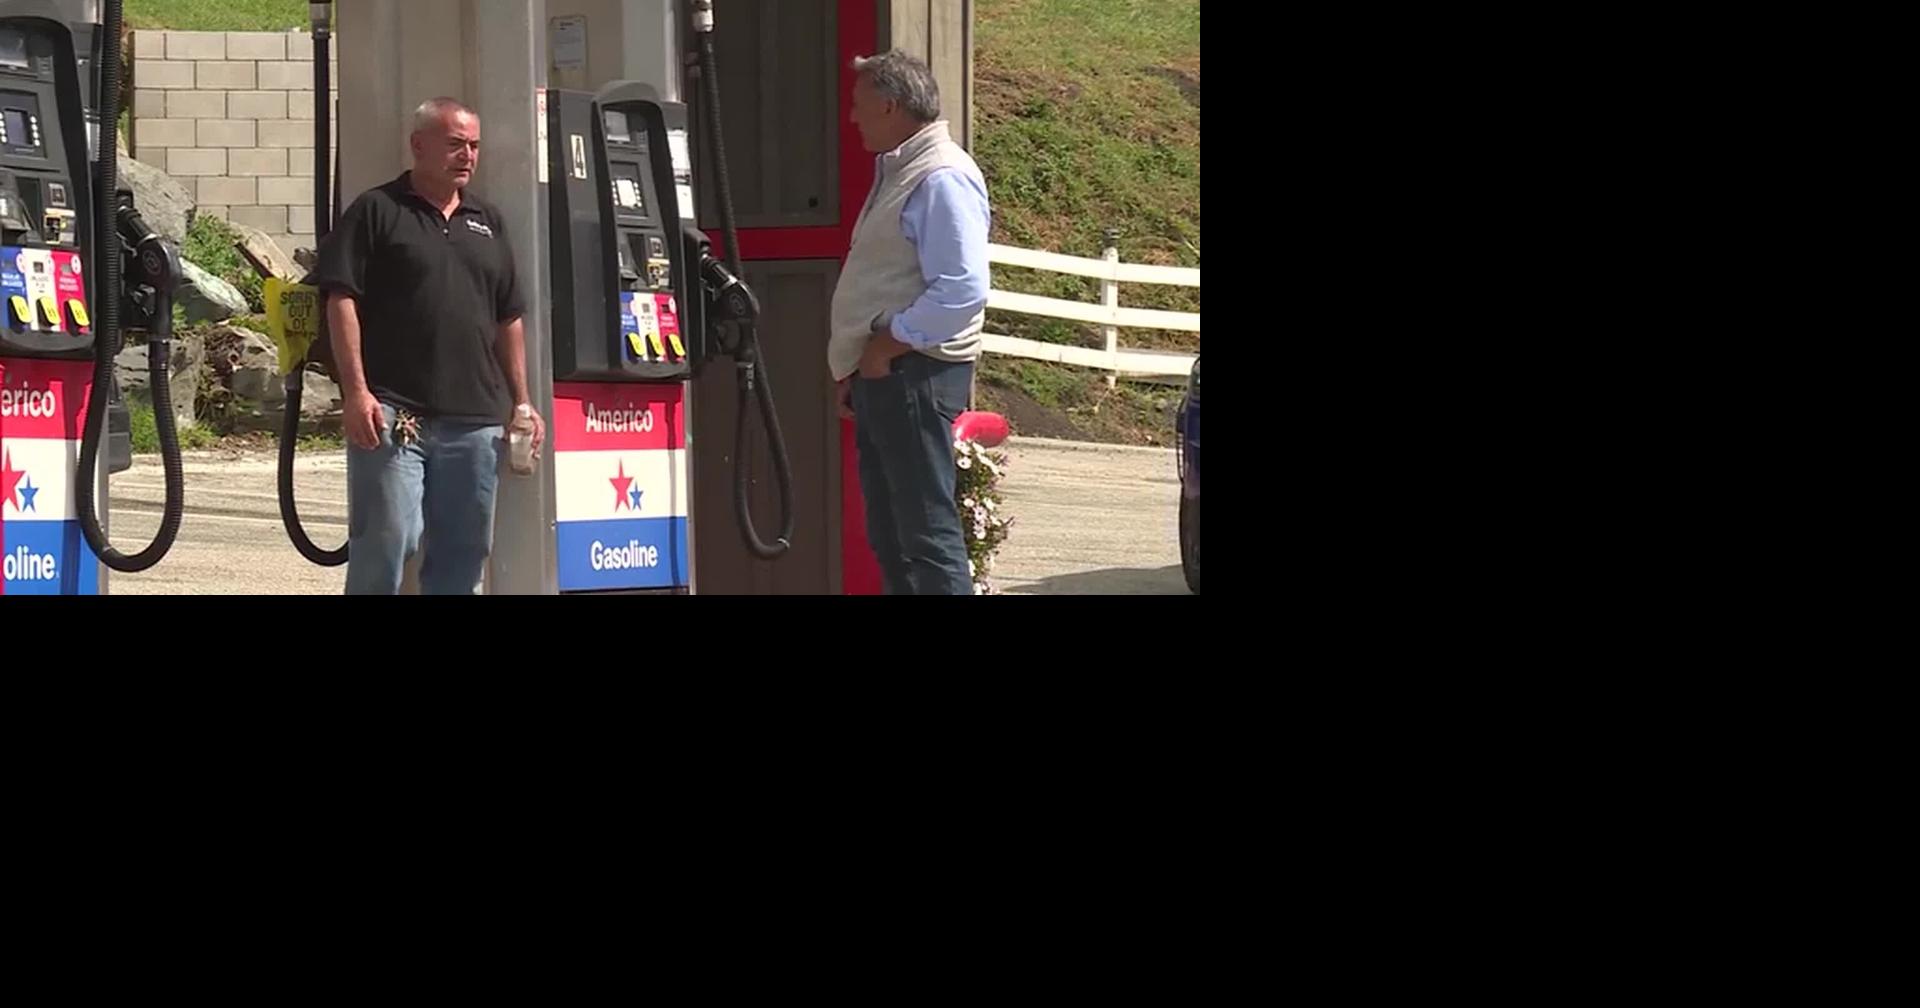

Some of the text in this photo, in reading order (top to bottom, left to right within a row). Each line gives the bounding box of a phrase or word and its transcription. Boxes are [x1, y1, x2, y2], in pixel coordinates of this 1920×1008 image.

[572, 137, 585, 177] 4
[585, 402, 654, 433] Americo
[3, 545, 55, 581] oline
[591, 540, 659, 571] Gasoline
